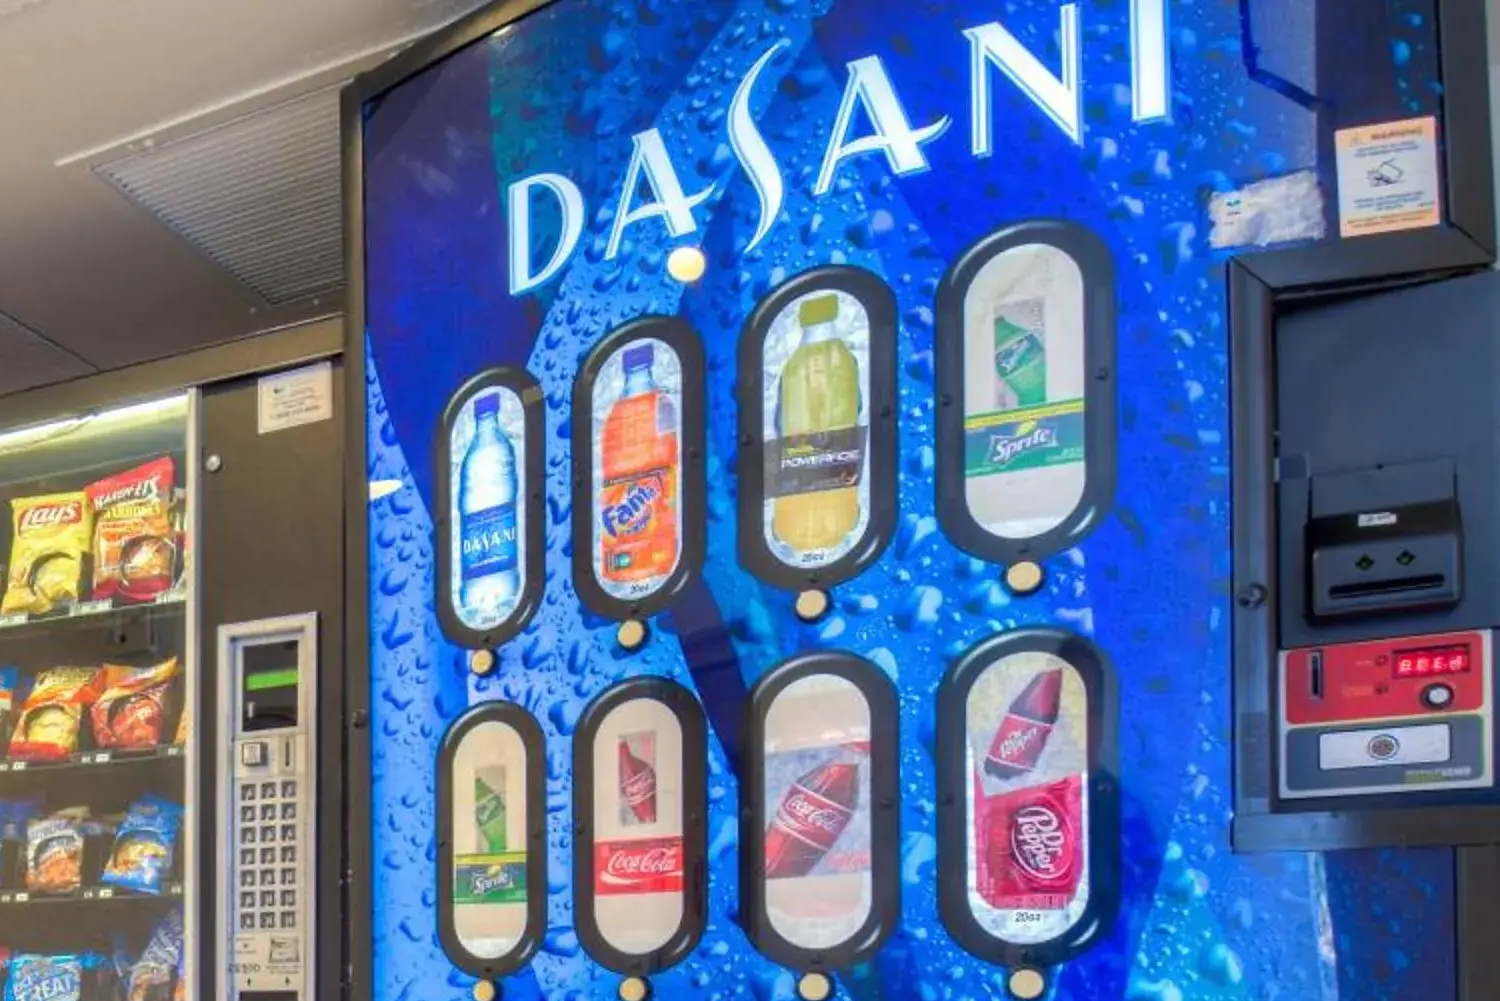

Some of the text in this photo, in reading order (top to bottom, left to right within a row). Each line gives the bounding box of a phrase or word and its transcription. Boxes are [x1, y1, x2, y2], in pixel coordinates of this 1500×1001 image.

[508, 0, 1172, 296] DASANI
[991, 427, 1052, 464] Sprite
[462, 526, 517, 554] DASANI
